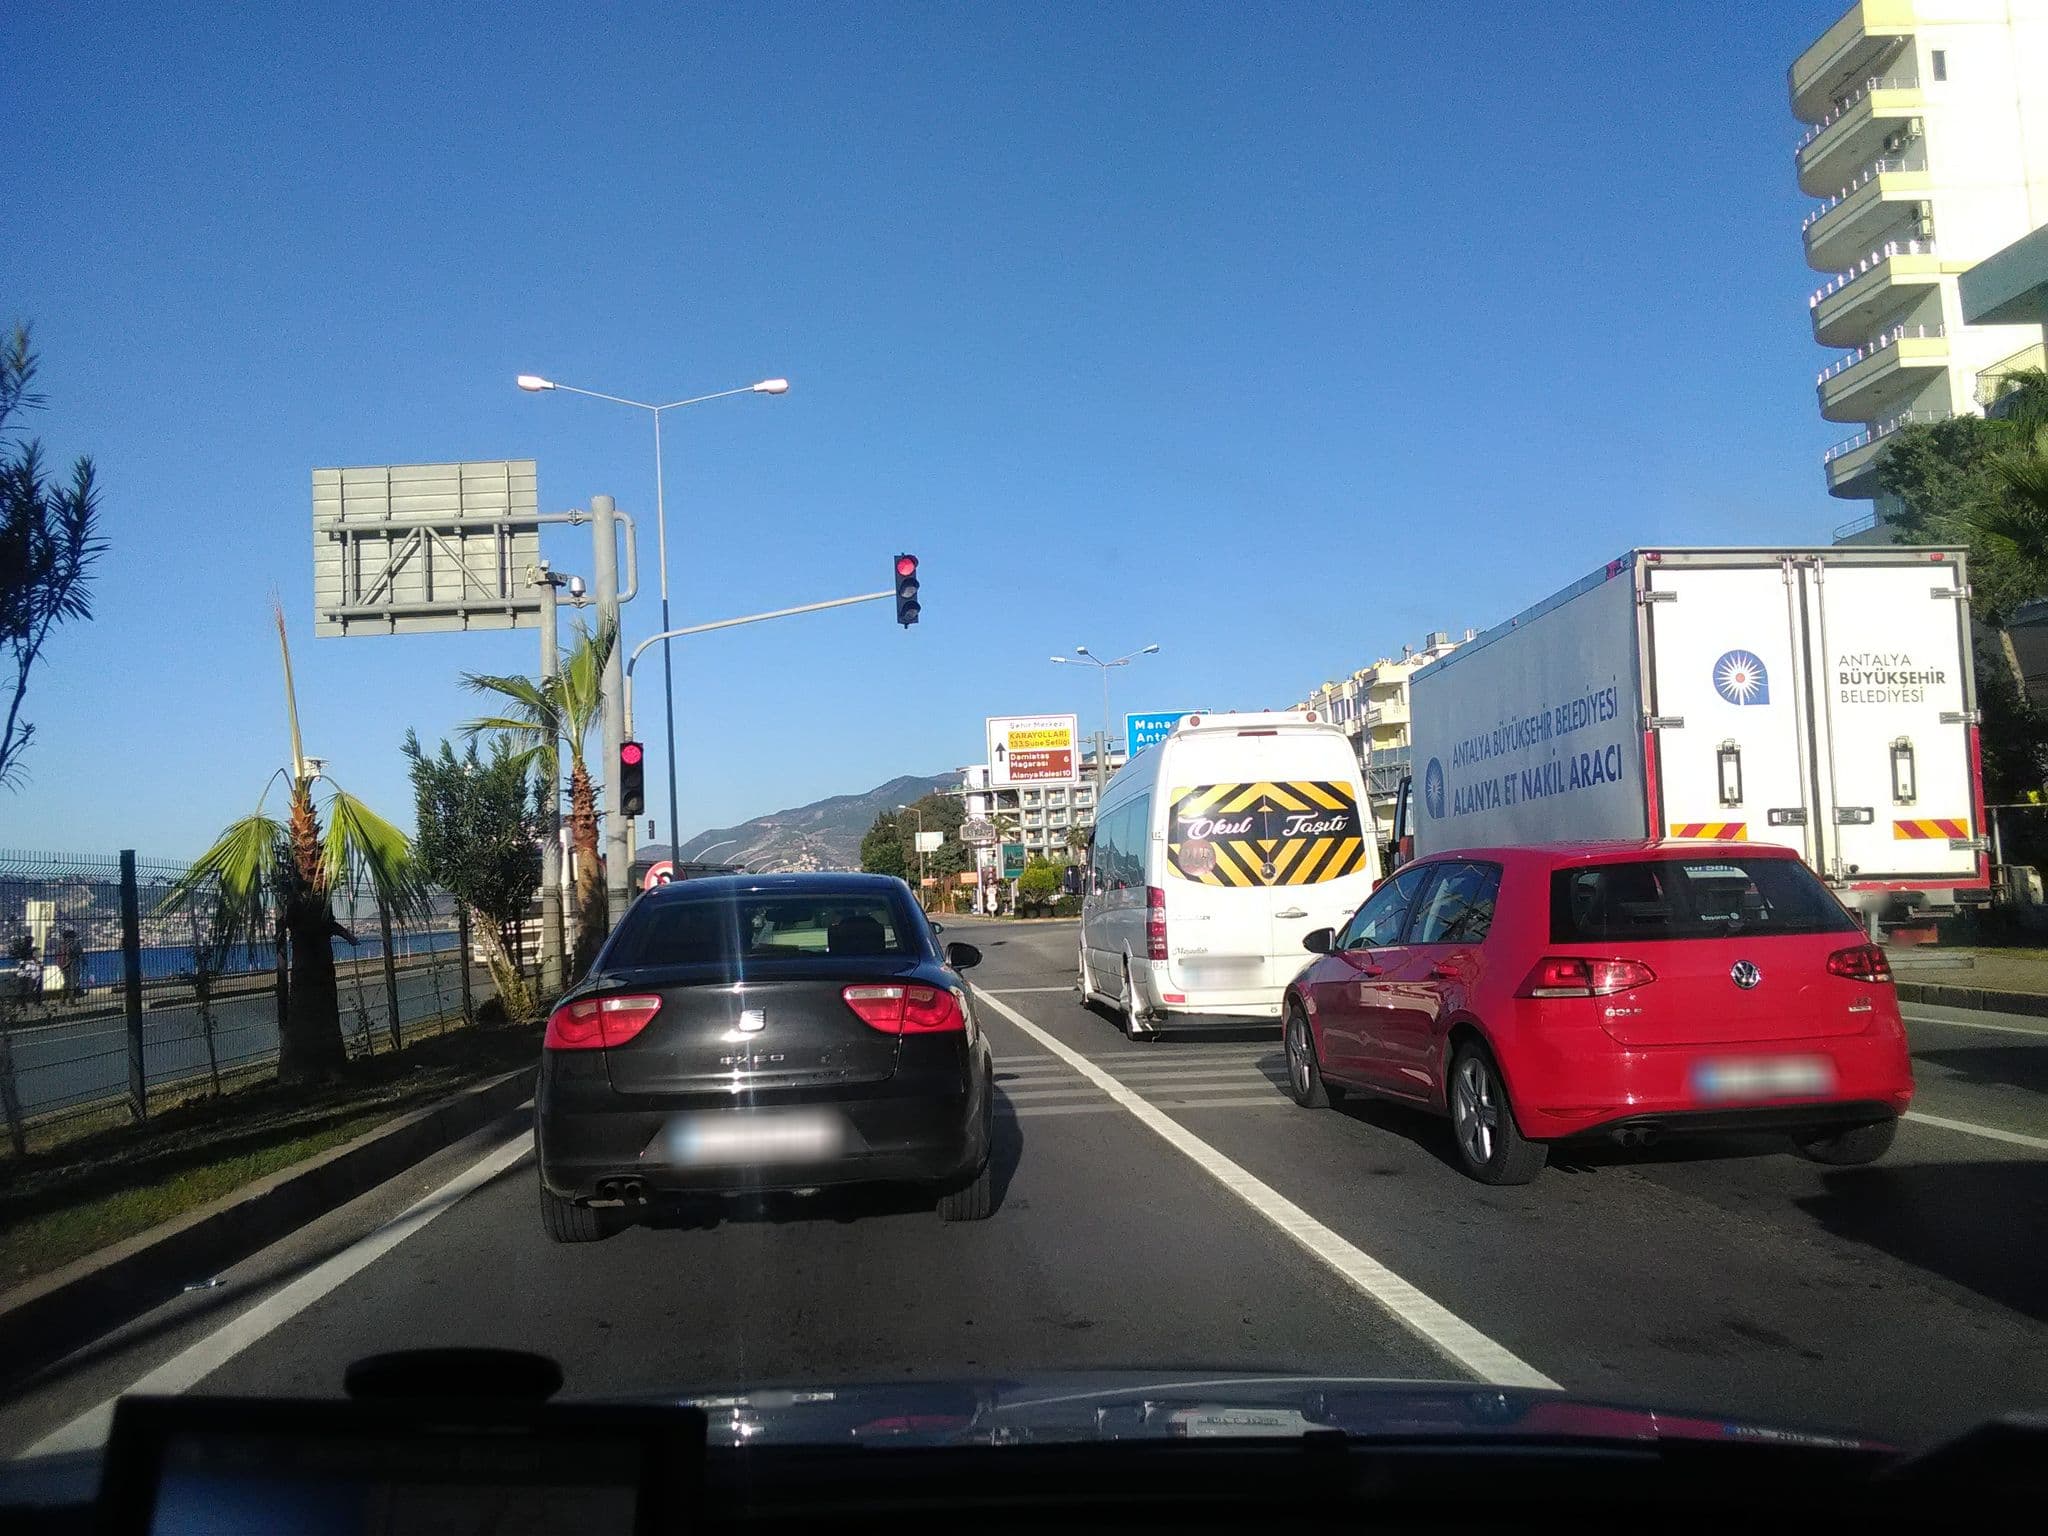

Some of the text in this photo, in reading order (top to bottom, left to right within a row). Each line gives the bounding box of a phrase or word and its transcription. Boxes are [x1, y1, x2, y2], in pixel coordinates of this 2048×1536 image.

[1838, 653, 1912, 667] ANTALYA
[1839, 667, 1946, 688] BÜYÜKŞEHİR
[1840, 686, 1925, 703] BELEDİYESİ
[1452, 674, 1619, 770] ANTALYA BÜYÜKŞEHİR BELEDİYESİ
[1009, 730, 1067, 740] KARAYOLLARI
[1011, 769, 1071, 780] Alanya Kalesi 10
[1453, 743, 1623, 817] ALANYA ET NAKİL ARACI
[1178, 816, 1253, 840] Okul
[1604, 1007, 1643, 1017] GOLF
